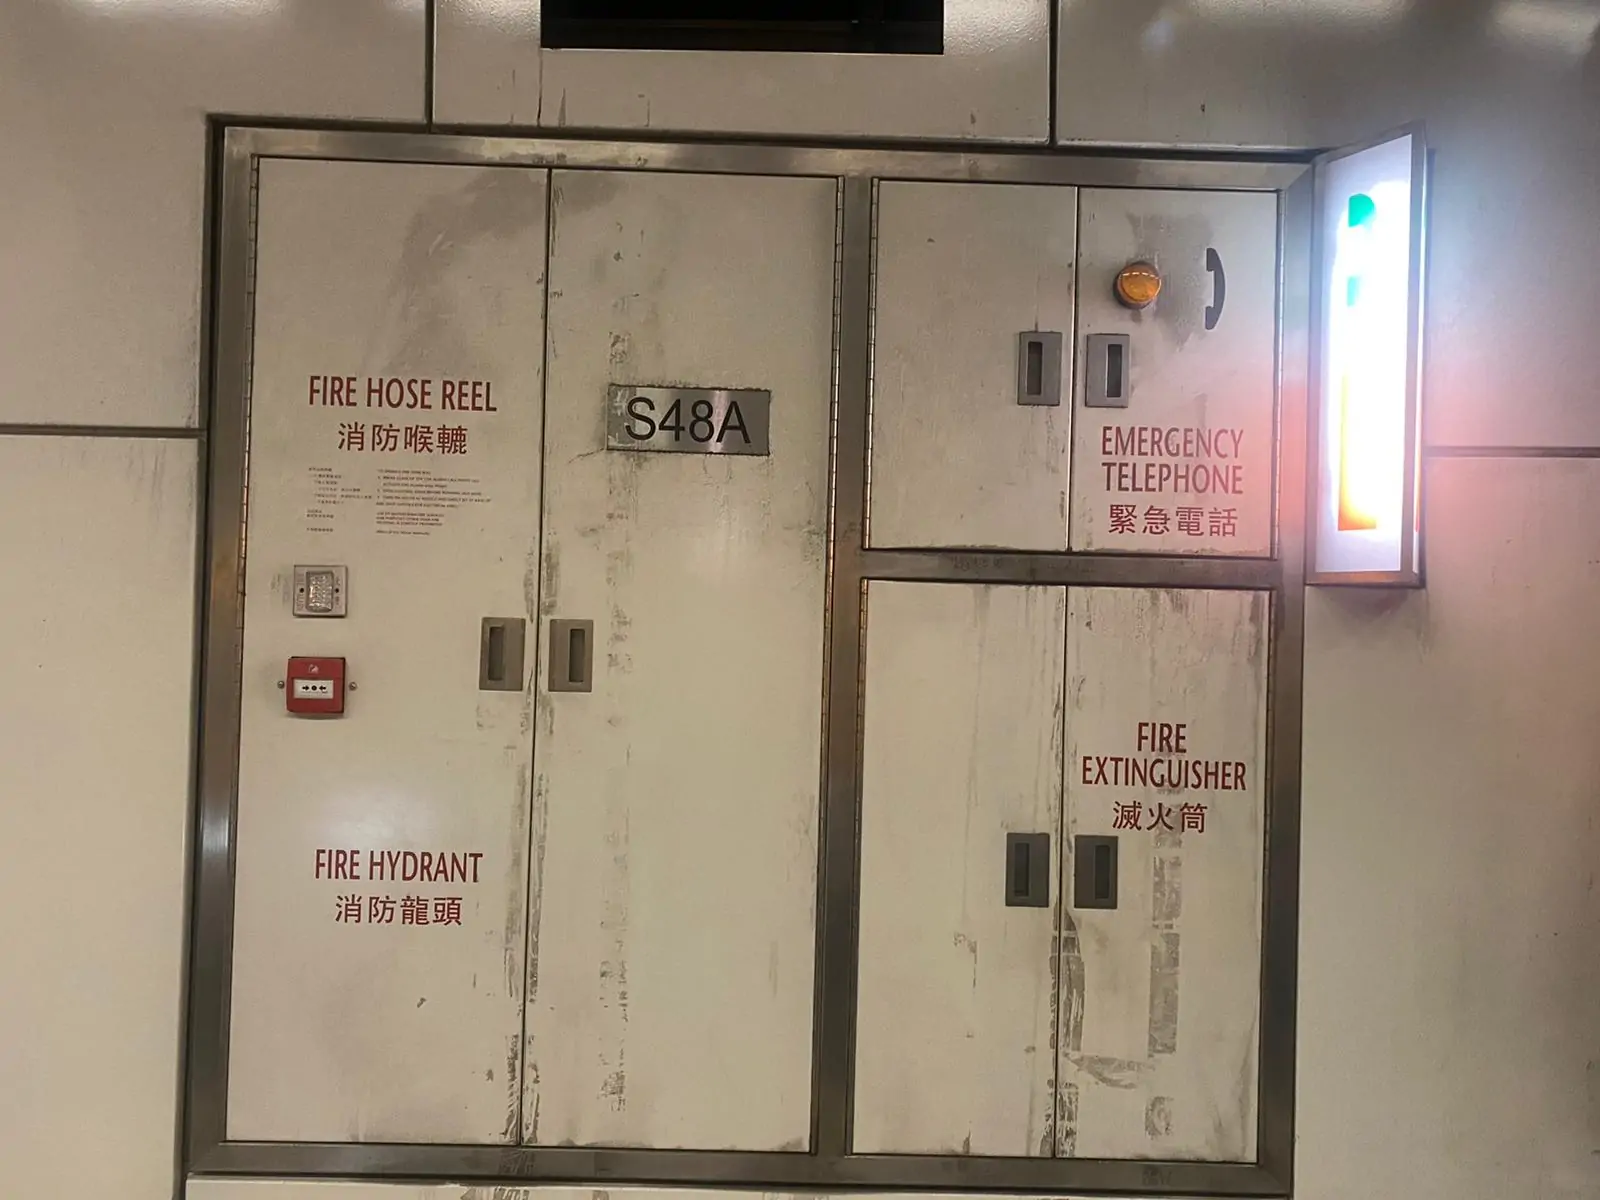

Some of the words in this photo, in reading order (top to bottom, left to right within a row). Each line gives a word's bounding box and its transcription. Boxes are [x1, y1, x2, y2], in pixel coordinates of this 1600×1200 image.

[309, 375, 357, 407] FIRE
[366, 377, 433, 410] HOSE
[442, 380, 498, 412] REEL
[626, 397, 750, 443] S48A
[337, 421, 469, 455] 消防喉轆
[1102, 426, 1244, 458] EMERGENCY
[1102, 462, 1244, 494] TELEPHONE
[1109, 504, 1238, 537] 緊急電話
[1137, 722, 1187, 754] FIRE
[1082, 756, 1247, 791] EXTINGUISHER
[1113, 800, 1208, 834] 滅火筒
[315, 849, 361, 881] FIRE
[369, 851, 484, 883] HYDRANT
[336, 894, 464, 927] 消防龍頭
